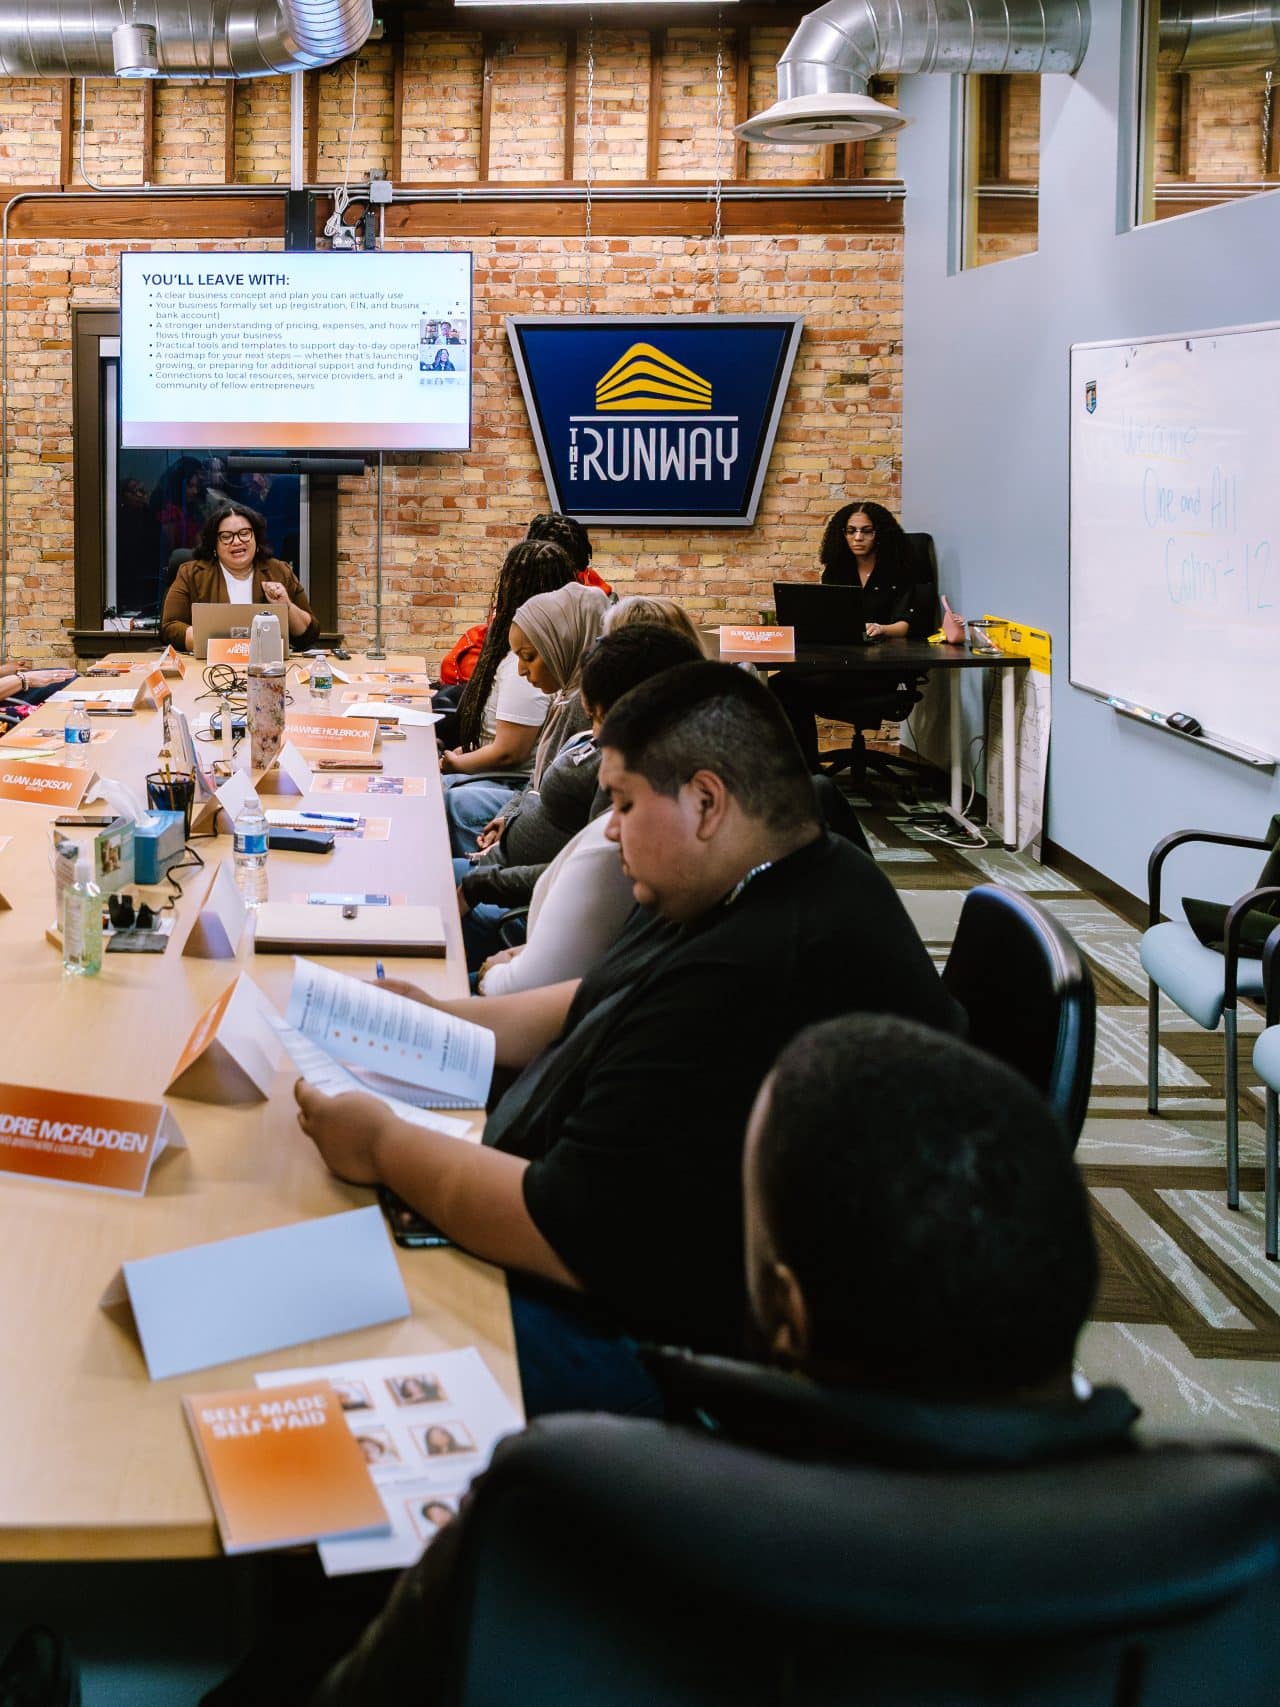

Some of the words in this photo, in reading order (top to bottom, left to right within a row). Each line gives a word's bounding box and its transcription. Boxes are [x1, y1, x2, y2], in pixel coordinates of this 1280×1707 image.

[142, 273, 194, 286] YOU'LL
[198, 273, 245, 286] LEAVE
[248, 273, 290, 286] WITH:
[155, 291, 163, 299] A
[164, 291, 186, 299] clear
[188, 291, 228, 299] business
[230, 291, 267, 302] concept
[269, 291, 287, 299] and
[289, 291, 309, 301] plan
[311, 293, 328, 301] you
[349, 291, 385, 301] actually
[155, 301, 176, 310] Your
[178, 301, 218, 310] business
[219, 301, 257, 311] formally
[259, 301, 272, 310] set
[275, 303, 287, 311] up
[290, 301, 348, 311] (registration,
[350, 301, 369, 311] EIN,
[370, 301, 388, 310] and
[156, 311, 178, 319] bank
[180, 311, 220, 320] account)
[155, 321, 163, 329] A
[164, 321, 202, 331] stronger
[205, 321, 272, 331] understanding
[274, 321, 284, 329] of
[286, 321, 320, 331] pricing,
[322, 323, 367, 331] expenses,
[368, 321, 386, 329] and
[389, 321, 408, 329] how
[155, 331, 179, 339] flows
[181, 331, 218, 341] through
[220, 333, 240, 341] your
[243, 331, 283, 339] business
[155, 341, 195, 349] Practical
[197, 341, 219, 349] tools
[221, 341, 238, 349] and
[241, 341, 288, 351] templates
[289, 341, 298, 349] to
[300, 341, 336, 351] support
[338, 341, 391, 351] day-to-day
[155, 351, 163, 359] A
[164, 351, 206, 361] roadmap
[207, 351, 220, 359] for
[222, 353, 242, 361] your
[245, 351, 264, 359] next
[267, 351, 291, 361] steps
[304, 351, 342, 359] whether
[345, 351, 369, 359] that's
[155, 362, 195, 371] growing,
[209, 361, 254, 371] preparing
[256, 361, 268, 369] for
[270, 361, 317, 369] additional
[319, 361, 358, 371] support
[357, 361, 375, 369] and
[377, 361, 413, 371] funding
[155, 371, 213, 379] Connections
[214, 371, 224, 379] to
[226, 371, 247, 379] local
[249, 373, 295, 381] resources,
[297, 371, 329, 379] service
[331, 371, 375, 381] providers,
[377, 371, 395, 379] and
[155, 381, 208, 391] community
[209, 381, 219, 390] of
[221, 381, 248, 390] fellow
[249, 381, 315, 391] entrepreneurs
[569, 428, 578, 480] THE
[583, 428, 739, 481] RUNWAY
[1142, 466, 1176, 528] One
[284, 725, 322, 735] HAWNIE
[323, 727, 371, 738] HOLBROOK
[2, 774, 30, 785] QUAN
[29, 778, 73, 791] JACKSON
[38, 1119, 149, 1153] MCFADDEN
[200, 1394, 328, 1424] SELF-MADE
[211, 1406, 326, 1440] SELF-PAID
